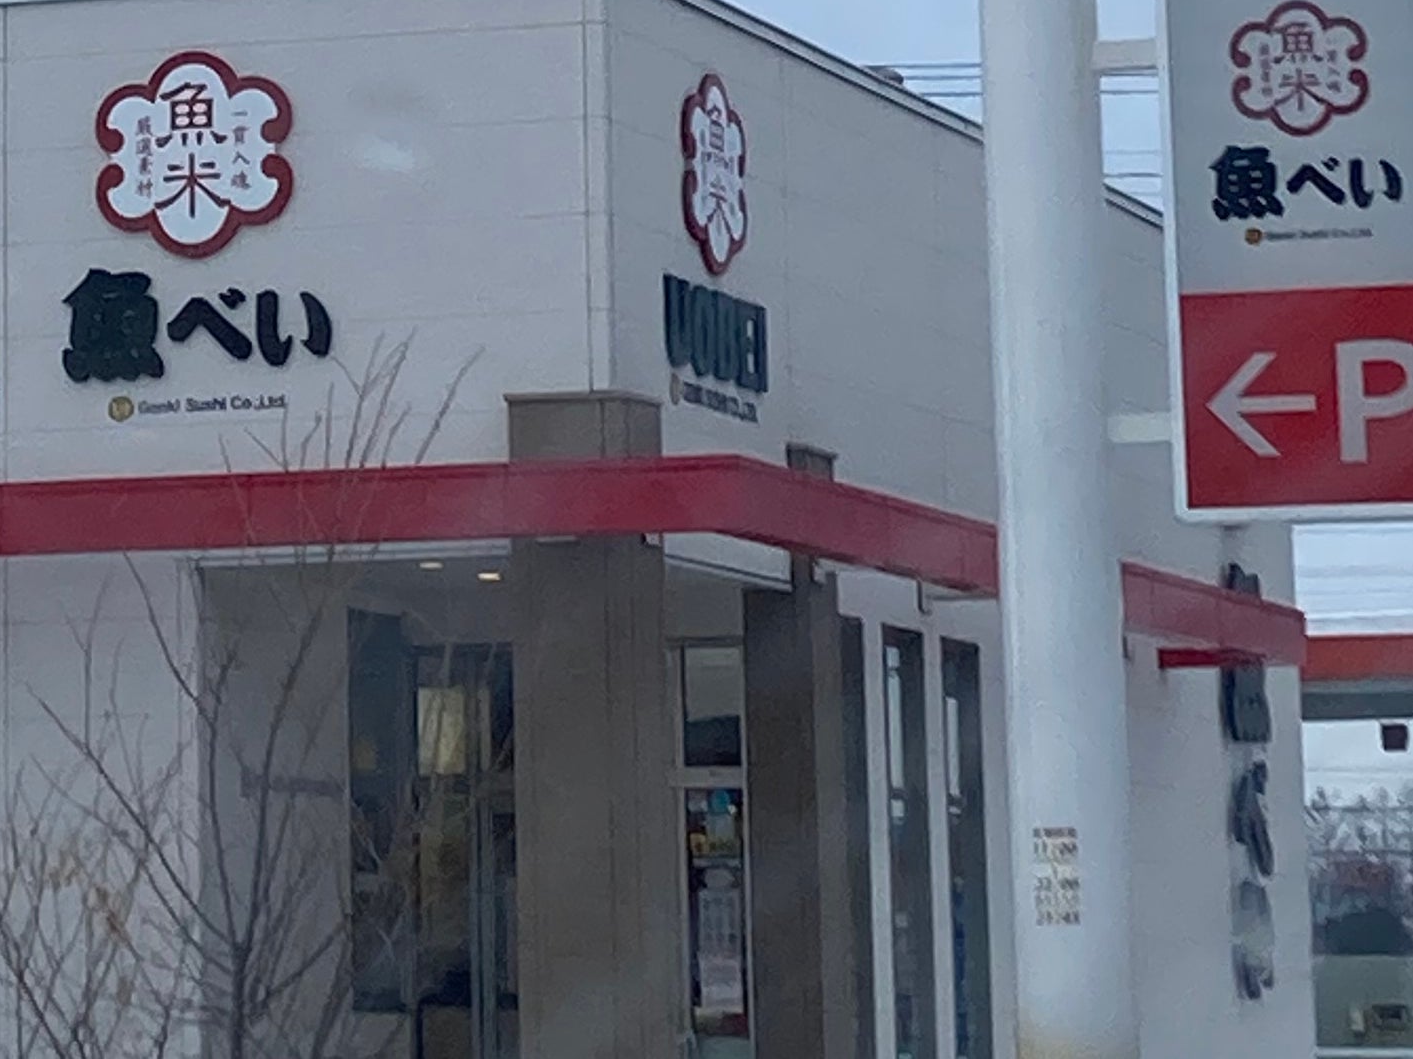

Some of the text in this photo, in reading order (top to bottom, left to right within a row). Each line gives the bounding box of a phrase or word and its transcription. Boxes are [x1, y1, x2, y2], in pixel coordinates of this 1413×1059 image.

[154, 82, 231, 218] 魚米
[1208, 145, 1403, 221] 魚べい
[62, 268, 333, 383] 魚べい
[1334, 338, 1413, 463] P
